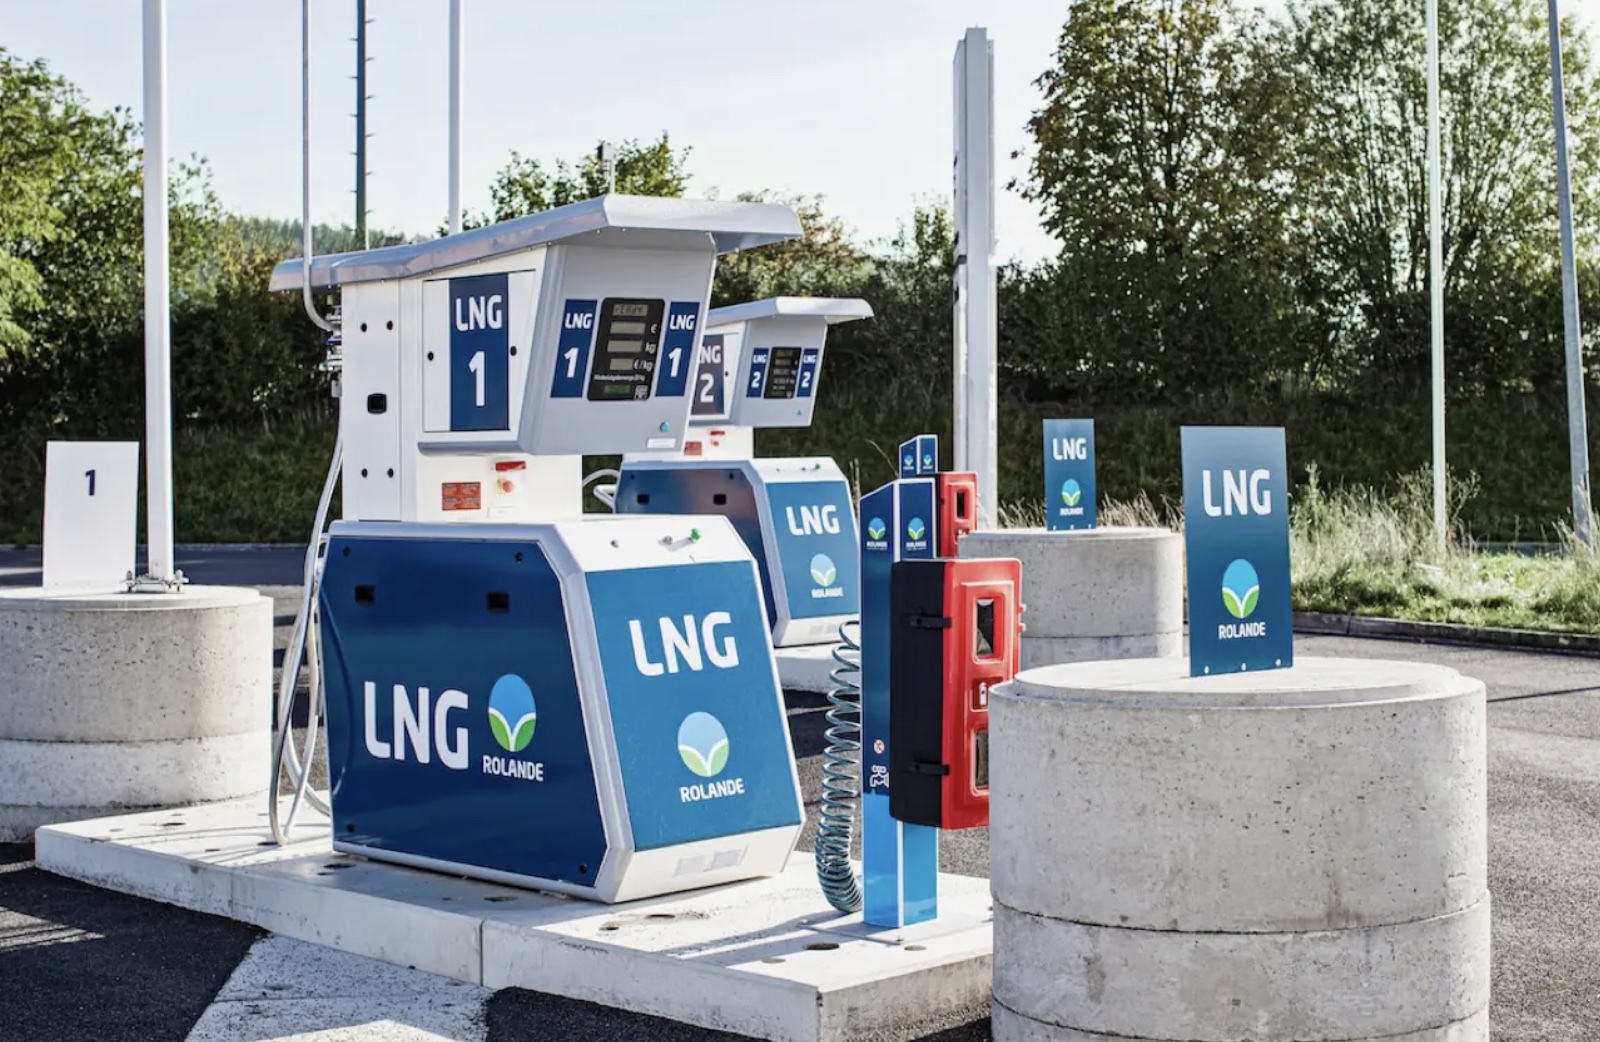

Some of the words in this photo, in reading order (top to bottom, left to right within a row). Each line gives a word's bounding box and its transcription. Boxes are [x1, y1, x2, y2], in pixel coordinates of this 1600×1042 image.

[455, 294, 502, 331] LNG
[565, 313, 592, 329] LNG
[669, 314, 695, 330] LNG
[645, 342, 657, 354] kg
[699, 345, 721, 364] NG
[564, 347, 579, 378] 1
[668, 347, 682, 378] 1
[468, 351, 485, 406] 1
[700, 373, 714, 402] 2
[751, 371, 761, 388] 2
[801, 371, 811, 388] 2
[1052, 437, 1087, 461] LNG
[85, 469, 96, 496] 1
[1202, 468, 1272, 517] LNG
[785, 504, 840, 535] LNG
[628, 611, 740, 676] LNG
[1218, 621, 1266, 640] ROLANDE
[364, 681, 469, 769] LNG
[482, 755, 544, 782] ROLANDE
[679, 777, 745, 803] ROLANDE
